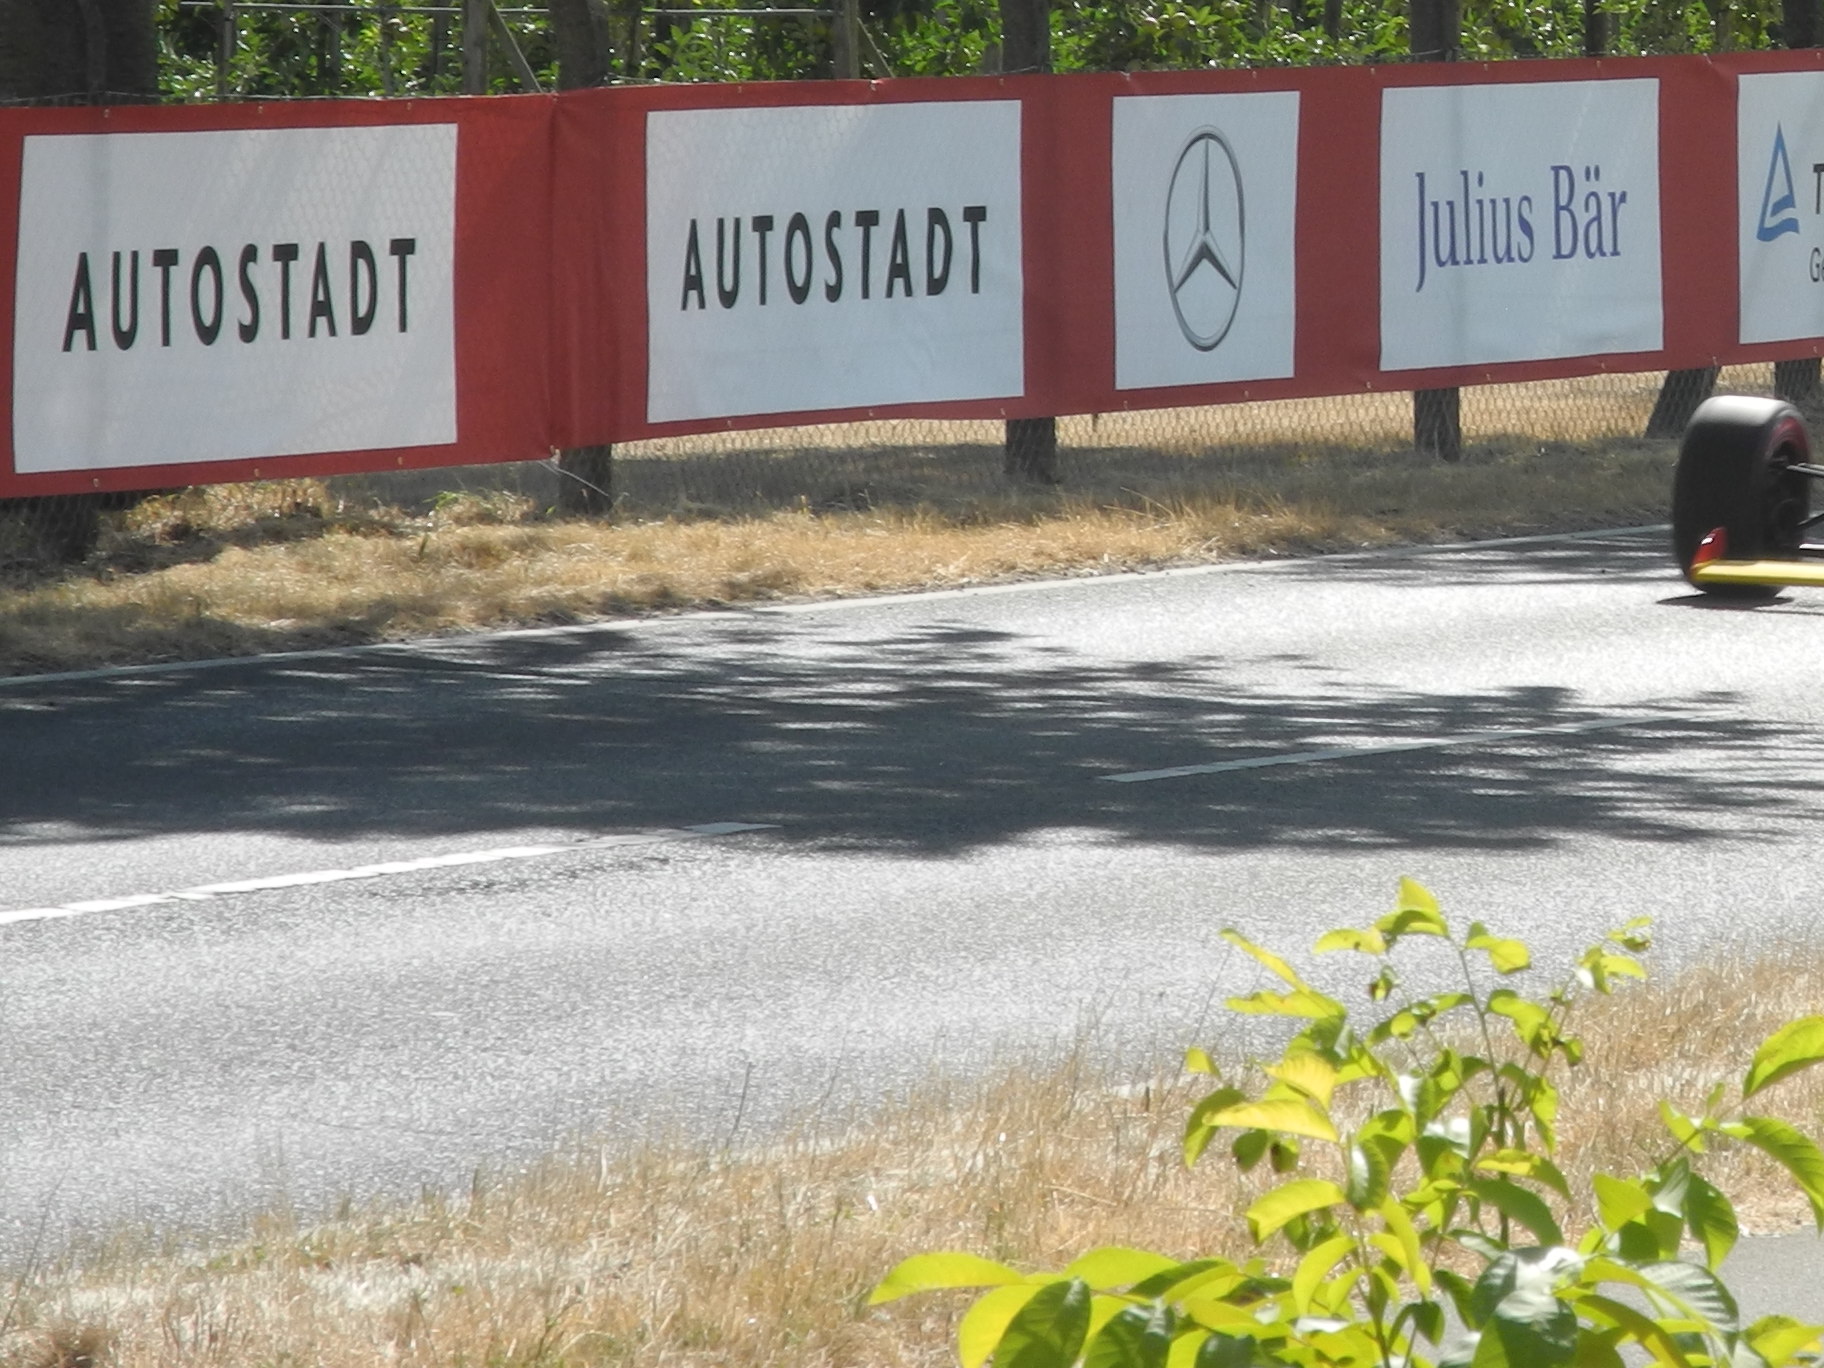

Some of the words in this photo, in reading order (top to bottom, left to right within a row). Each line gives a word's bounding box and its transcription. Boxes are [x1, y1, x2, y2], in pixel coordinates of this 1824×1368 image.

[681, 204, 988, 311] AUTOSTADT
[1414, 169, 1535, 293] Julius
[1550, 164, 1628, 260] Bär
[62, 237, 416, 352] AUTOSTADT
